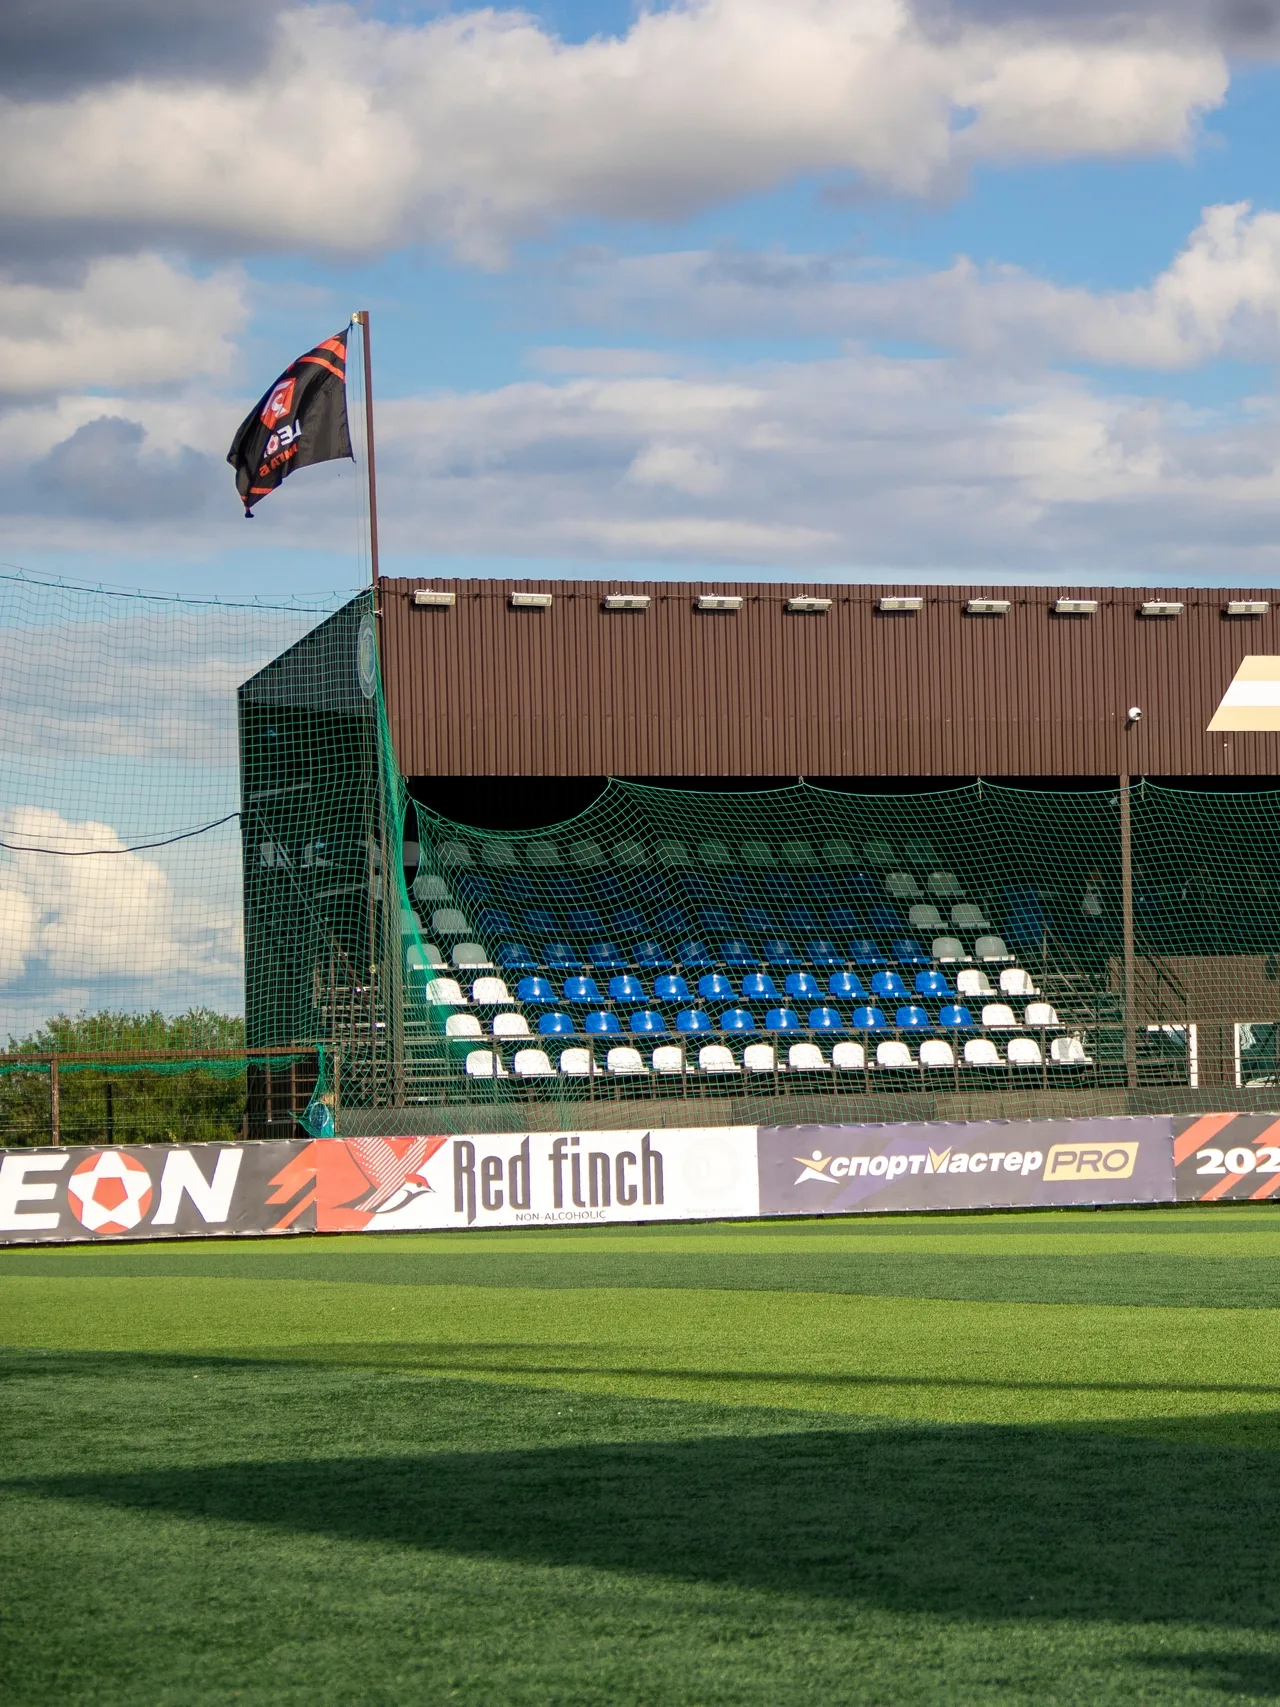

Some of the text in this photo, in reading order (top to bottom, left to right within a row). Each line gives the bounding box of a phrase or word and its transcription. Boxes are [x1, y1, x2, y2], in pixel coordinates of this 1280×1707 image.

[453, 1131, 665, 1226] Red finch
[830, 1146, 1130, 1180] спортМастер PRO
[515, 1210, 607, 1222] NON-ALCOHOLIC
